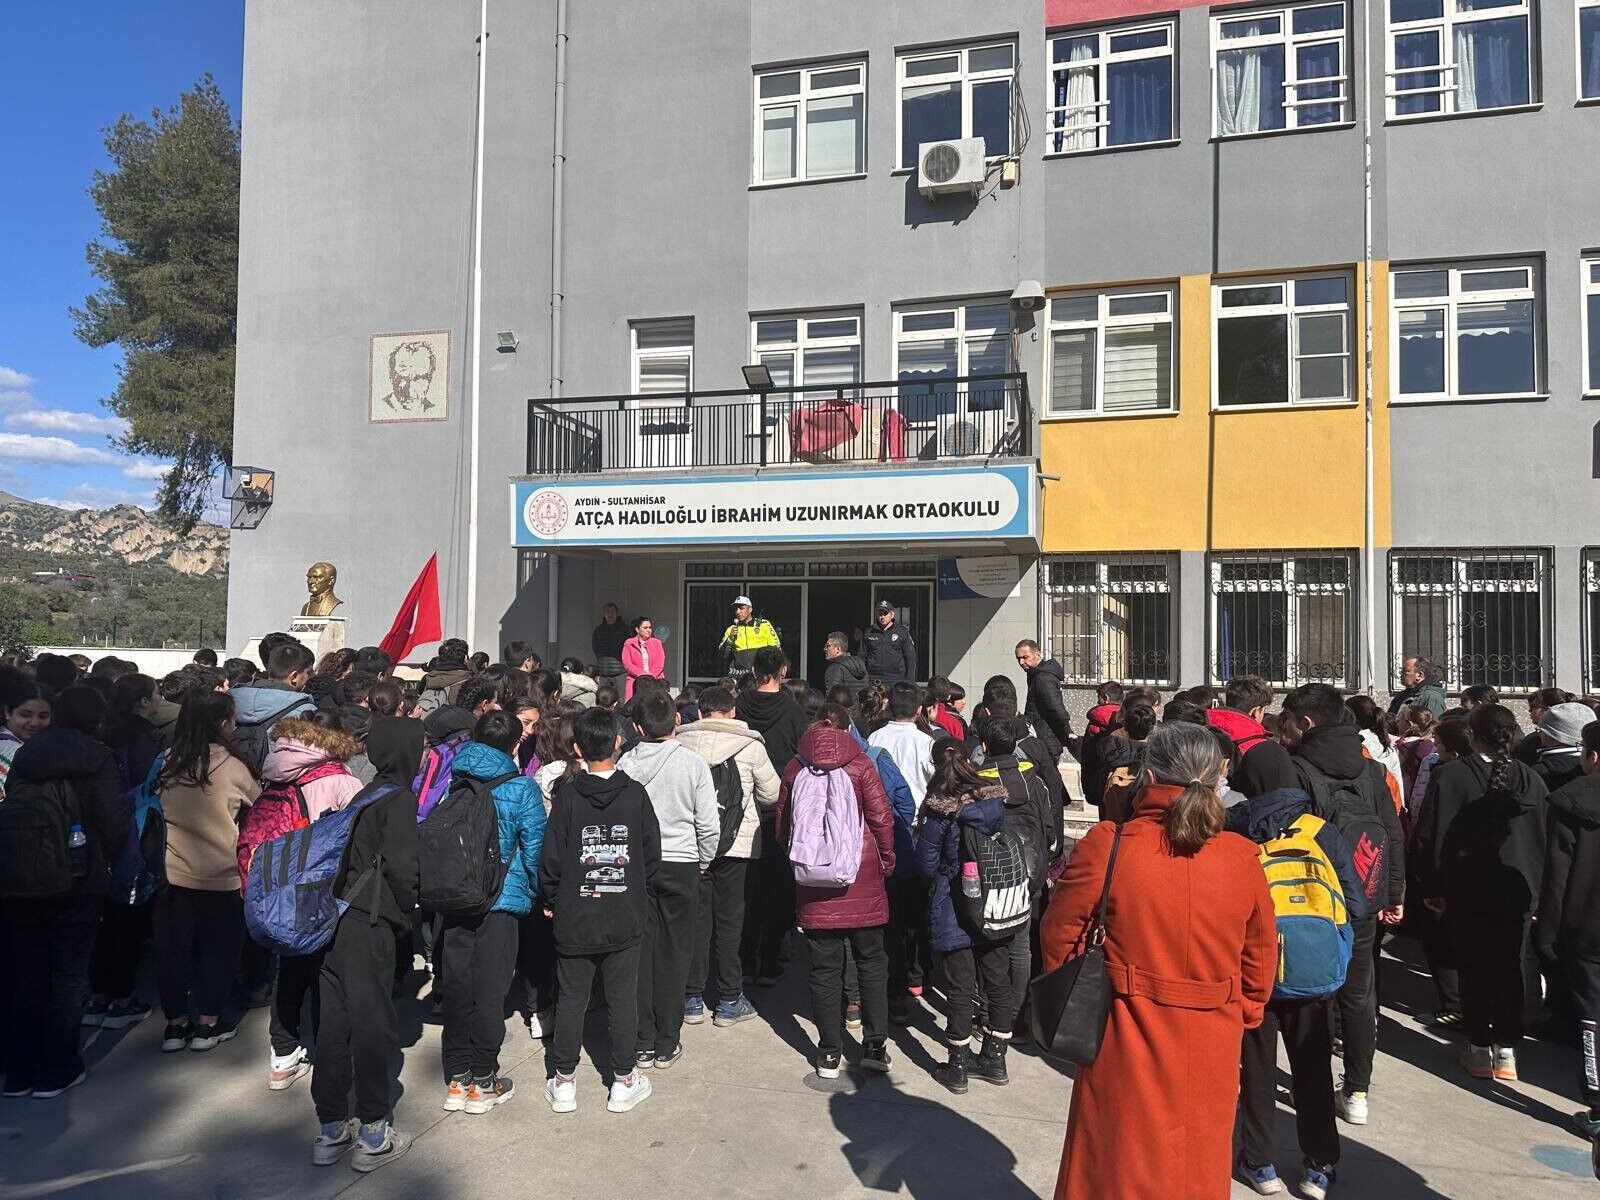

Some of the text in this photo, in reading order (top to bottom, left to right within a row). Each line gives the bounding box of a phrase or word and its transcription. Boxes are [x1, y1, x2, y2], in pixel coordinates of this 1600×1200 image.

[574, 498, 600, 507] AYDIN
[607, 494, 666, 507] SULTANHİSAR
[574, 511, 615, 529] ATÇA
[617, 506, 707, 525] HADILOĞLU
[711, 503, 781, 523] İBRAHİM
[786, 504, 888, 522] UZUNIRMAK
[892, 500, 1001, 520] ORTAOKULU
